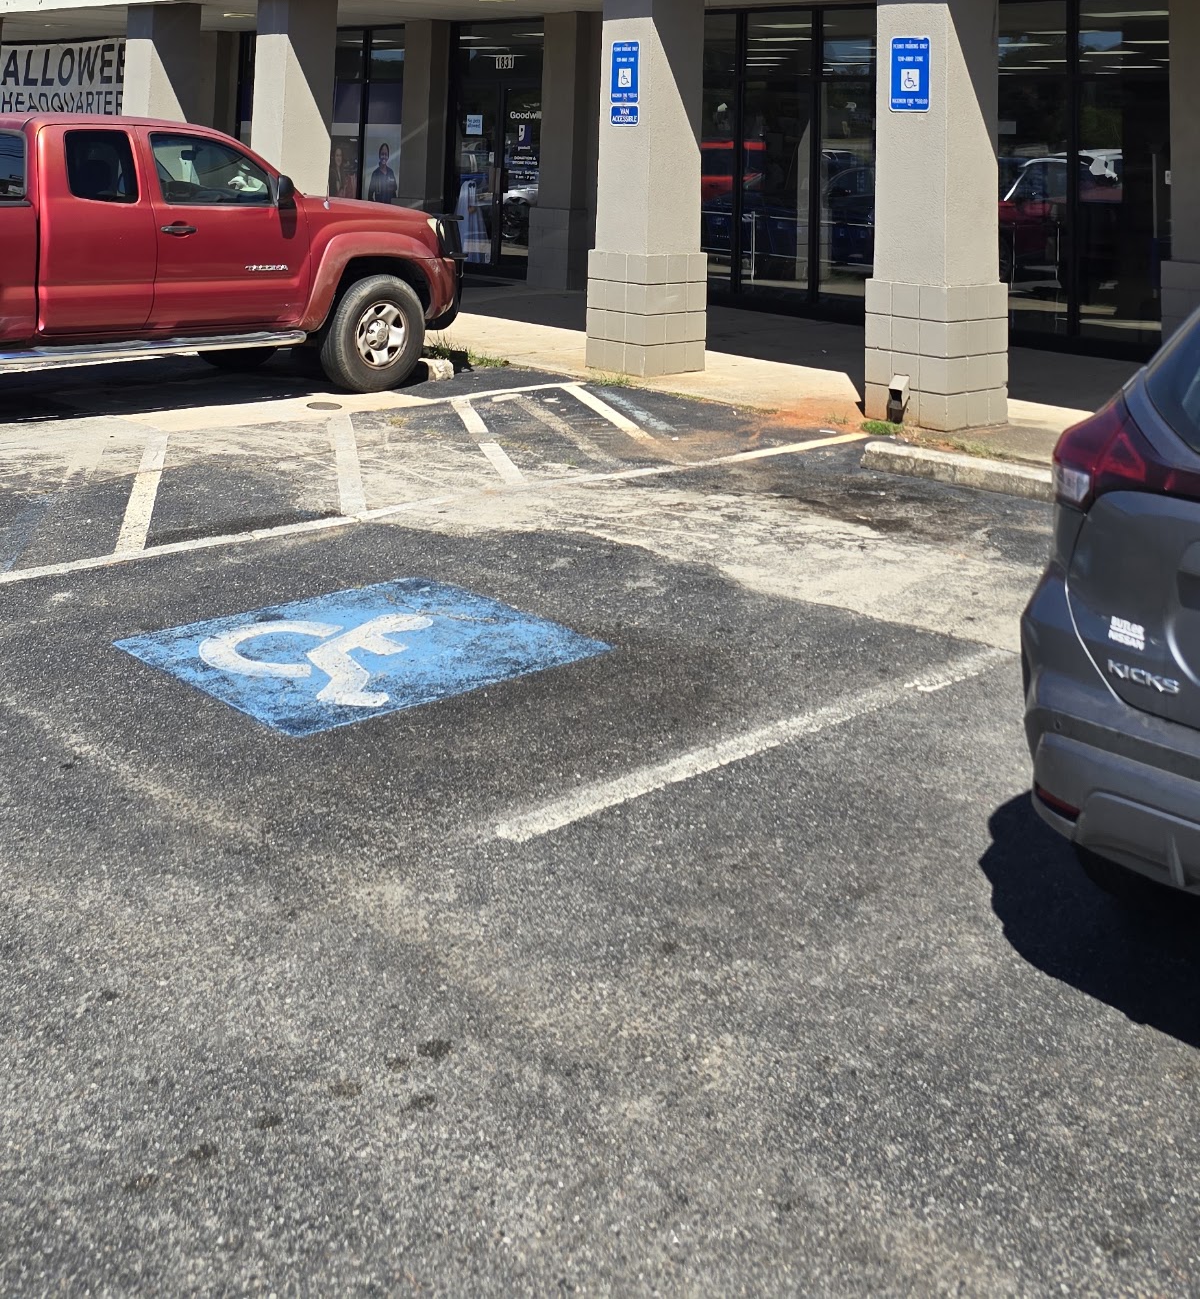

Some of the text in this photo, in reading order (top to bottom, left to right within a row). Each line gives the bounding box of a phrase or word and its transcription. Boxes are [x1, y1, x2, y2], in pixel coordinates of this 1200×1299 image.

[496, 56, 514, 68] 1831
[612, 115, 638, 123] ACCESSIBLE
[1108, 629, 1145, 651] NISSAN
[1107, 658, 1180, 694] KICKS
